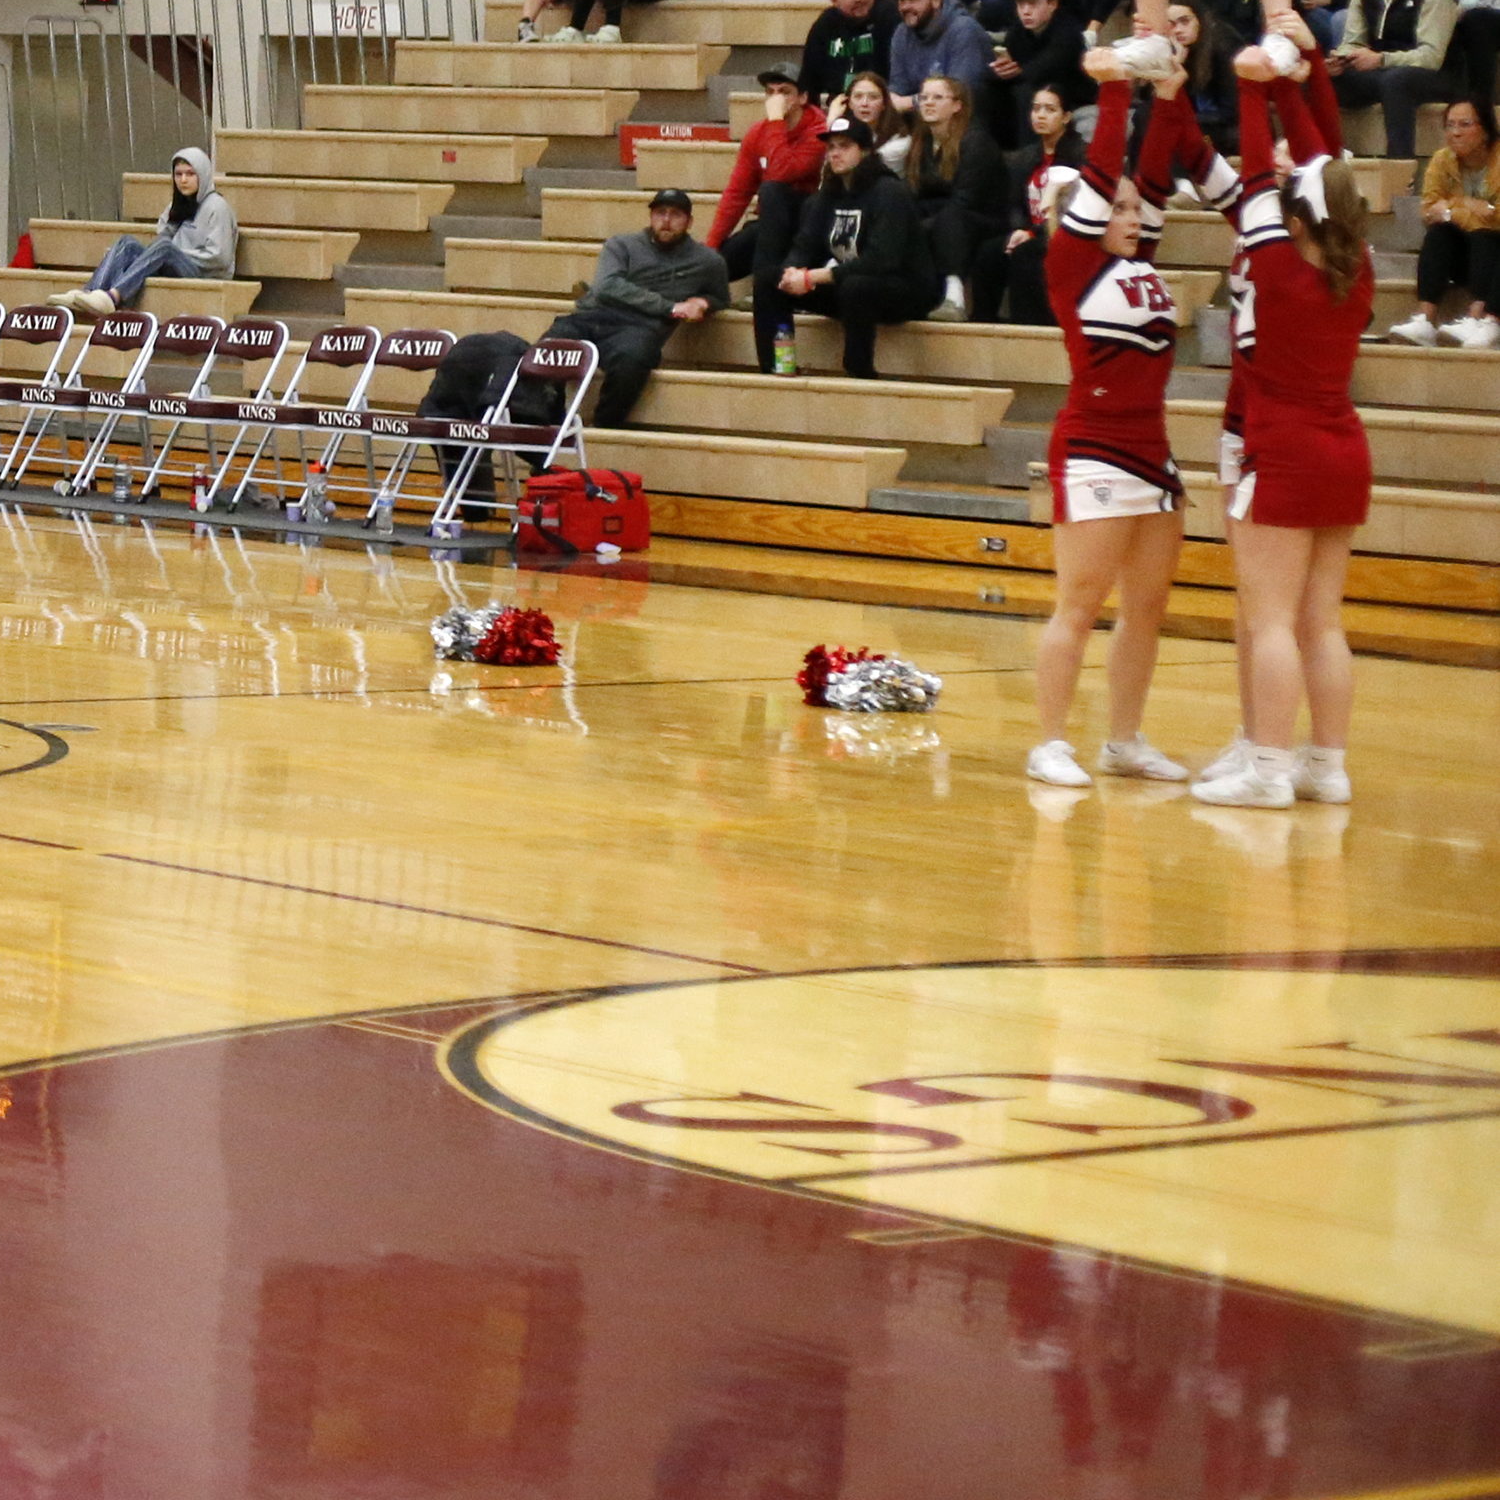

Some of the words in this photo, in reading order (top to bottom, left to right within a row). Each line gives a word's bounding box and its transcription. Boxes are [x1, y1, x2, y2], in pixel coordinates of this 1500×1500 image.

[11, 314, 57, 329] KAYHI
[321, 335, 365, 351] KAYHI
[533, 348, 581, 366] KAYHI
[319, 411, 361, 426] KINGS
[450, 422, 489, 439] KINGS
